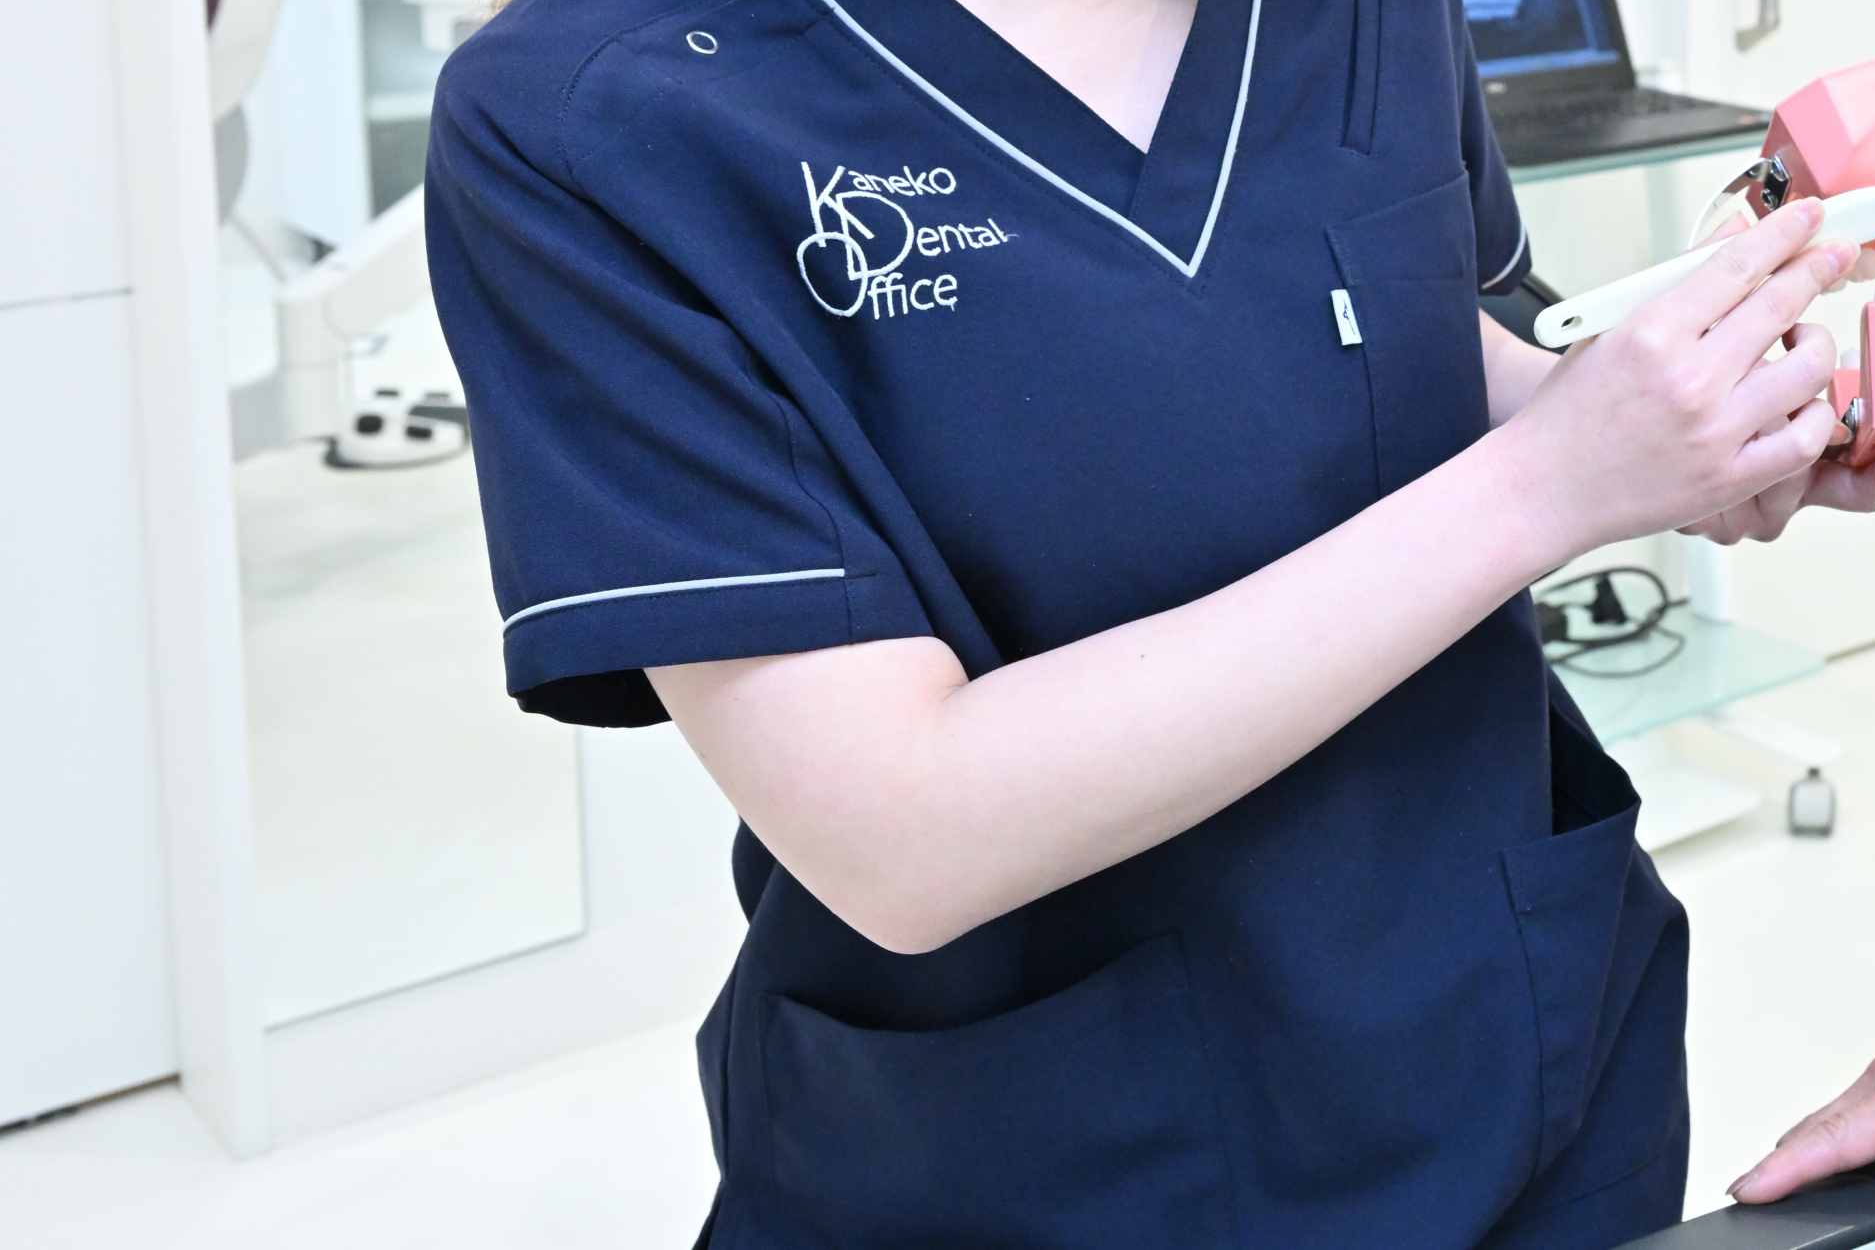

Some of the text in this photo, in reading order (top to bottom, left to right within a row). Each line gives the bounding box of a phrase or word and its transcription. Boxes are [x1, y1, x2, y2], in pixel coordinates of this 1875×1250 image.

[800, 161, 956, 247] Kaneko
[835, 190, 1010, 281] Dental
[796, 231, 957, 320] Office
